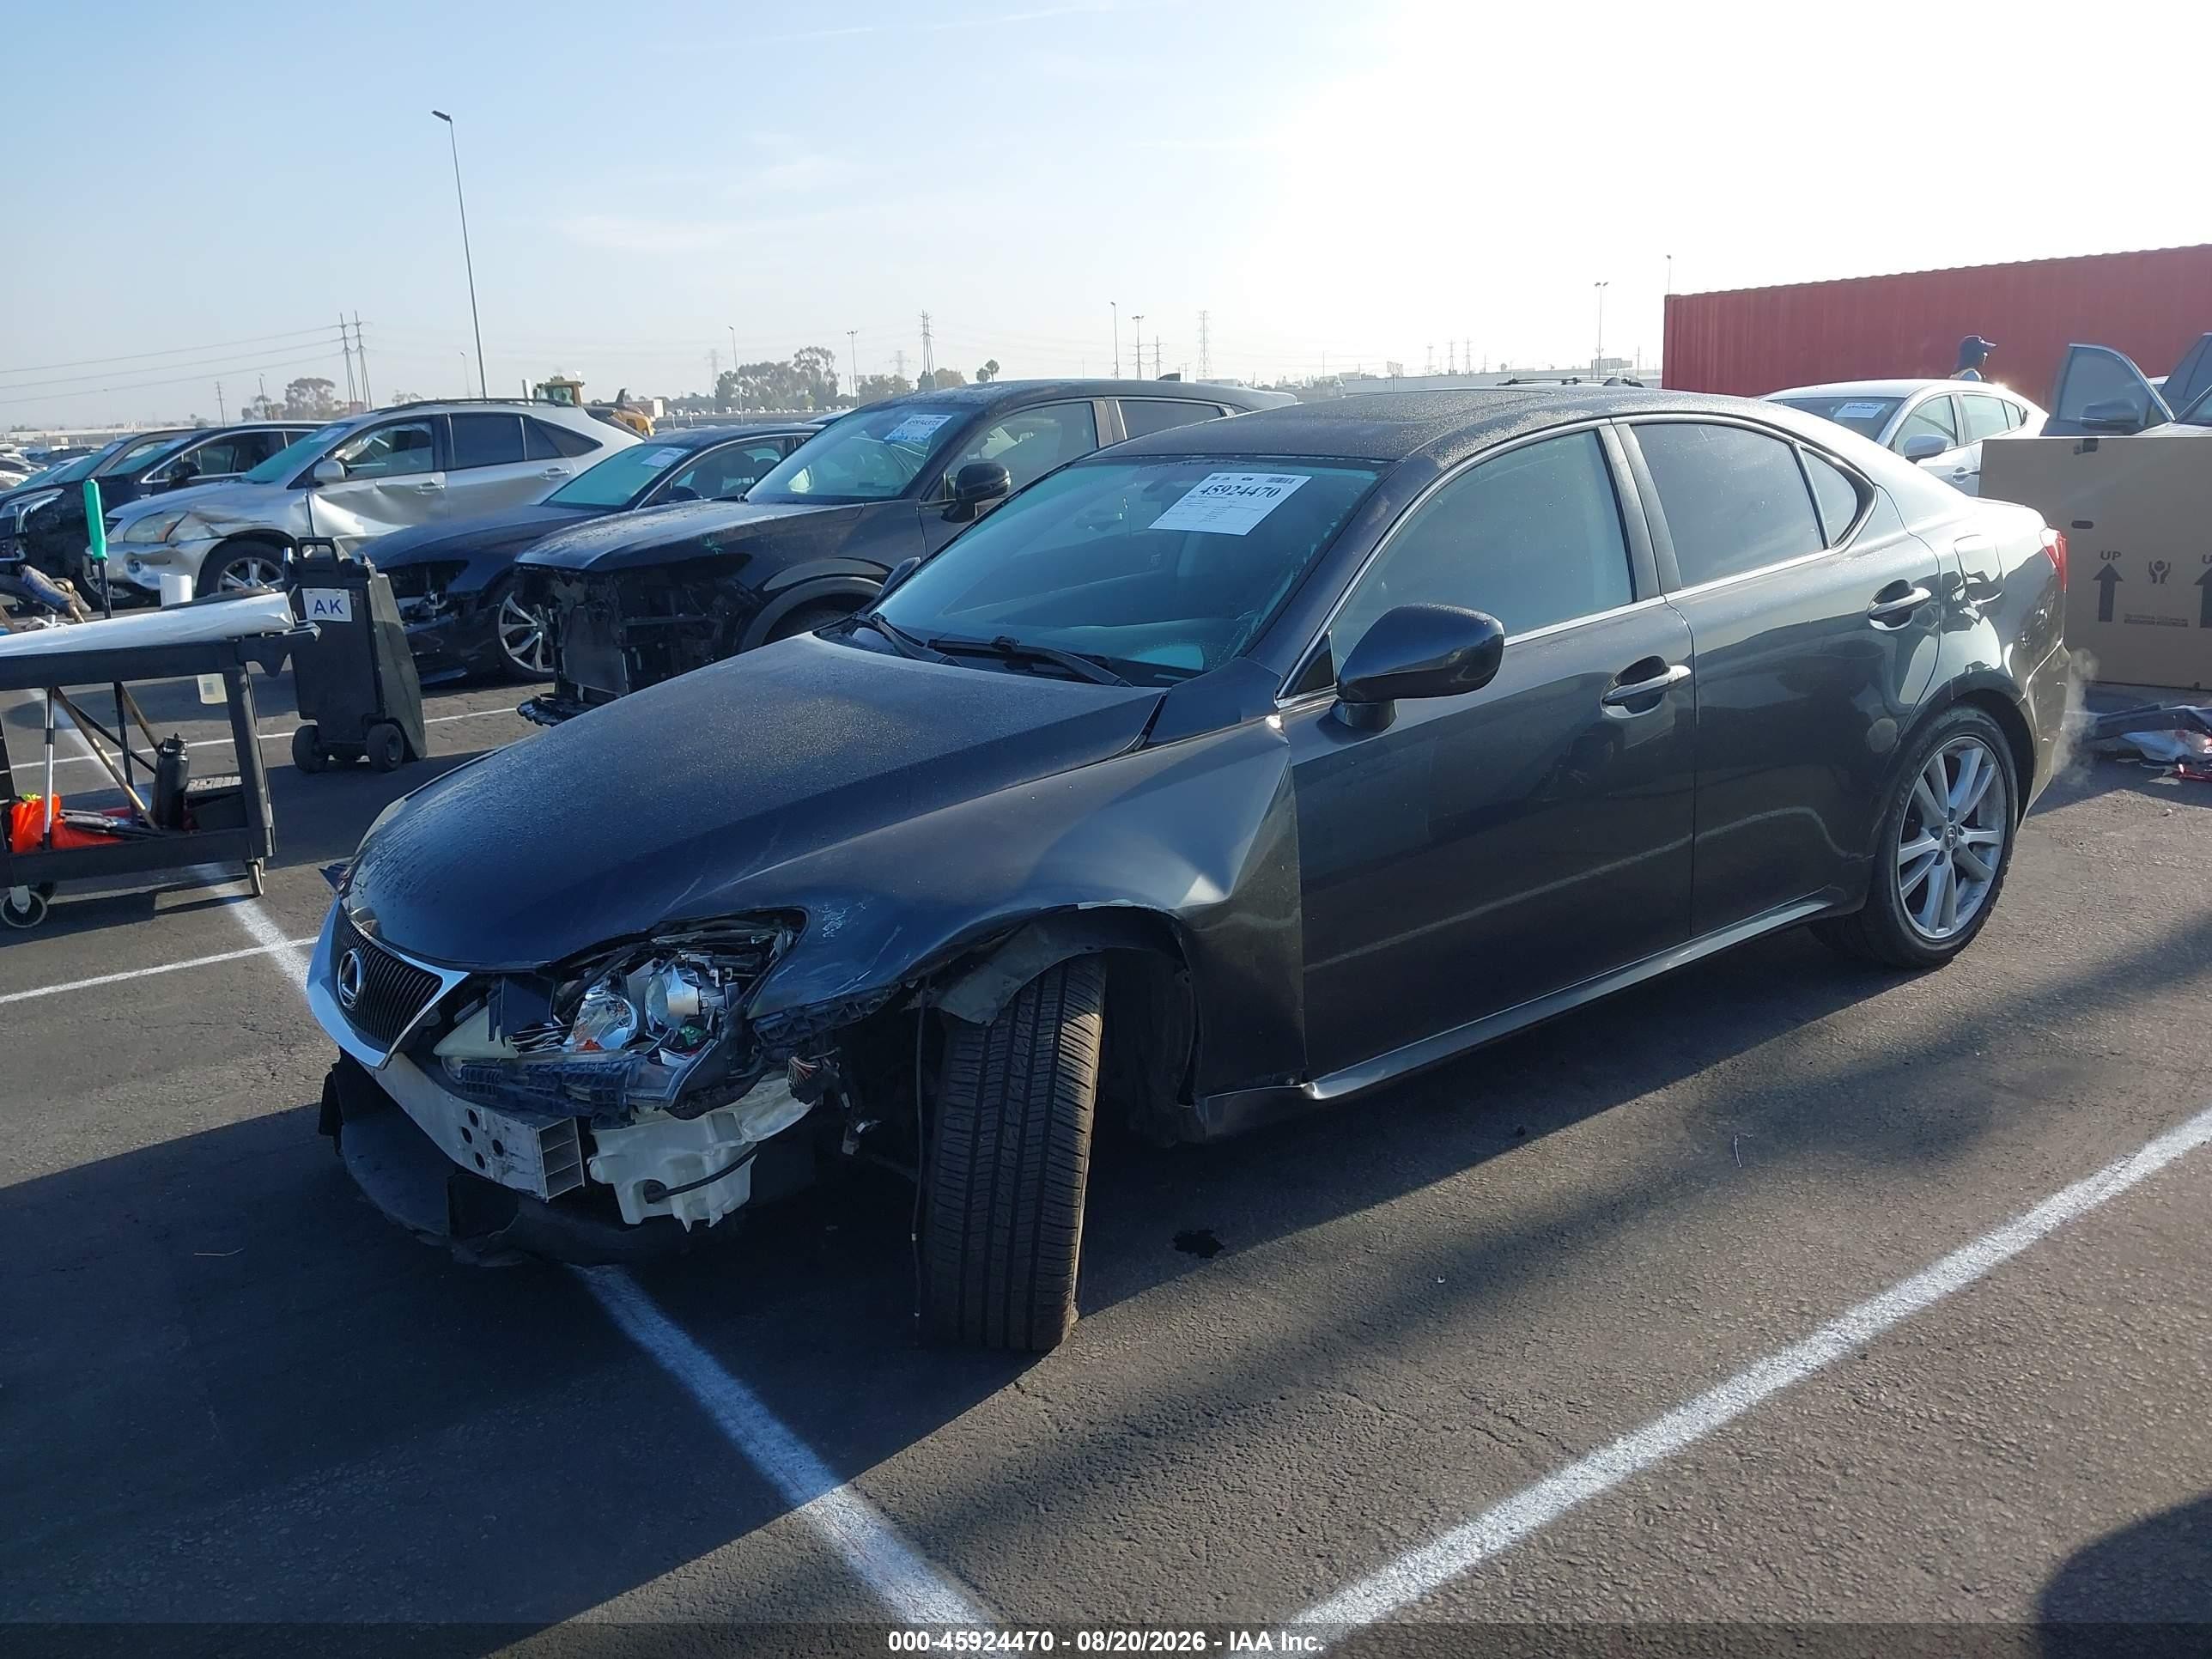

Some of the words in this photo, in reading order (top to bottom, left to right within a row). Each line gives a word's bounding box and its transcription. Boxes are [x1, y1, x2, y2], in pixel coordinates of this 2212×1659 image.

[1199, 484, 1282, 498] 45924470
[2100, 550, 2122, 561] UP
[2202, 554, 2212, 564] U
[313, 599, 343, 615] AK
